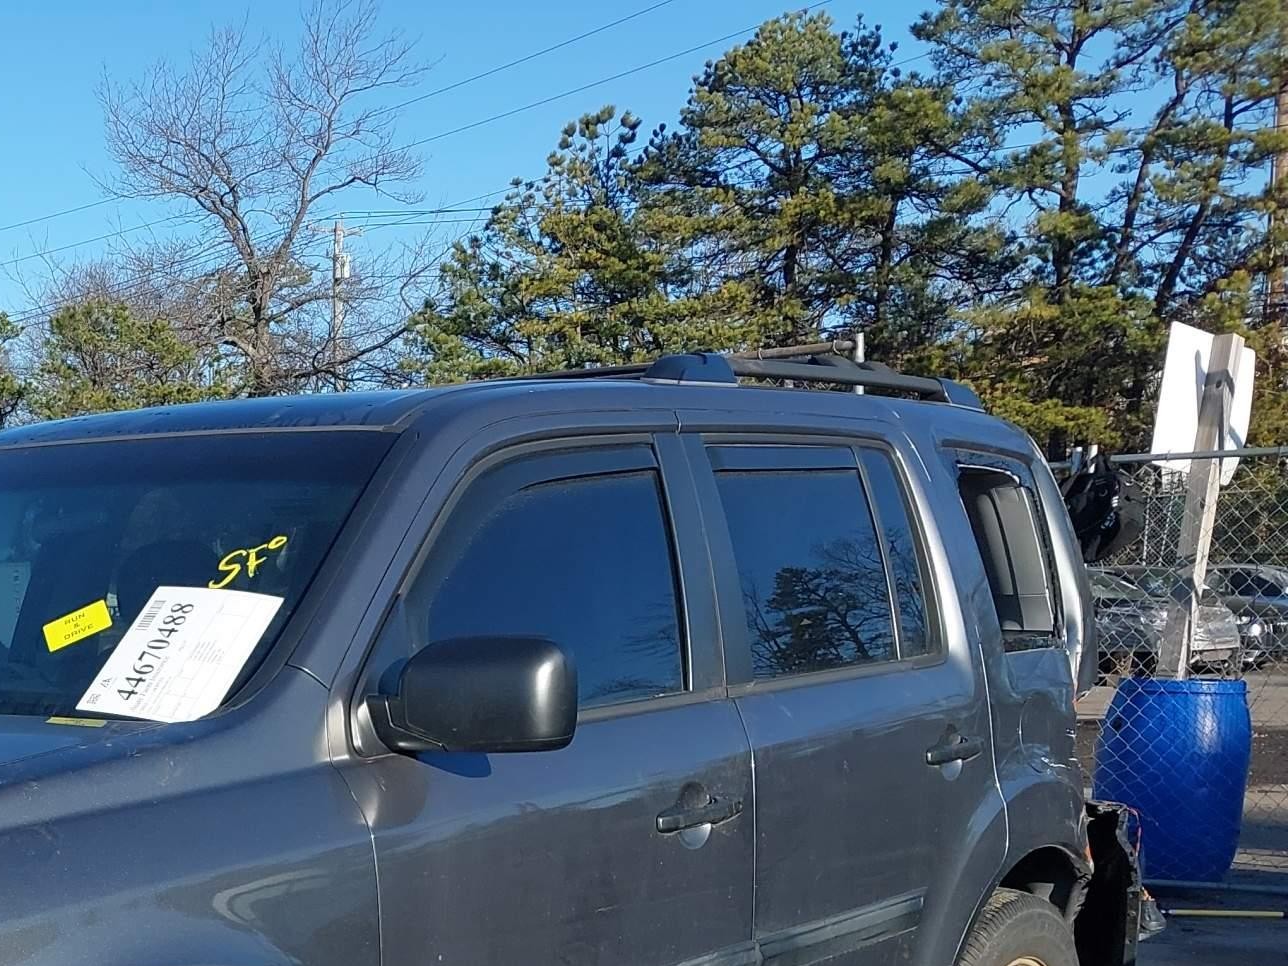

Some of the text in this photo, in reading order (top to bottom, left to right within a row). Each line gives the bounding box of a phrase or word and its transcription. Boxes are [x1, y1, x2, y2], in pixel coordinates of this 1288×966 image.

[63, 611, 86, 625] RUN
[63, 623, 95, 641] DRIVE
[116, 602, 195, 701] 44670488
